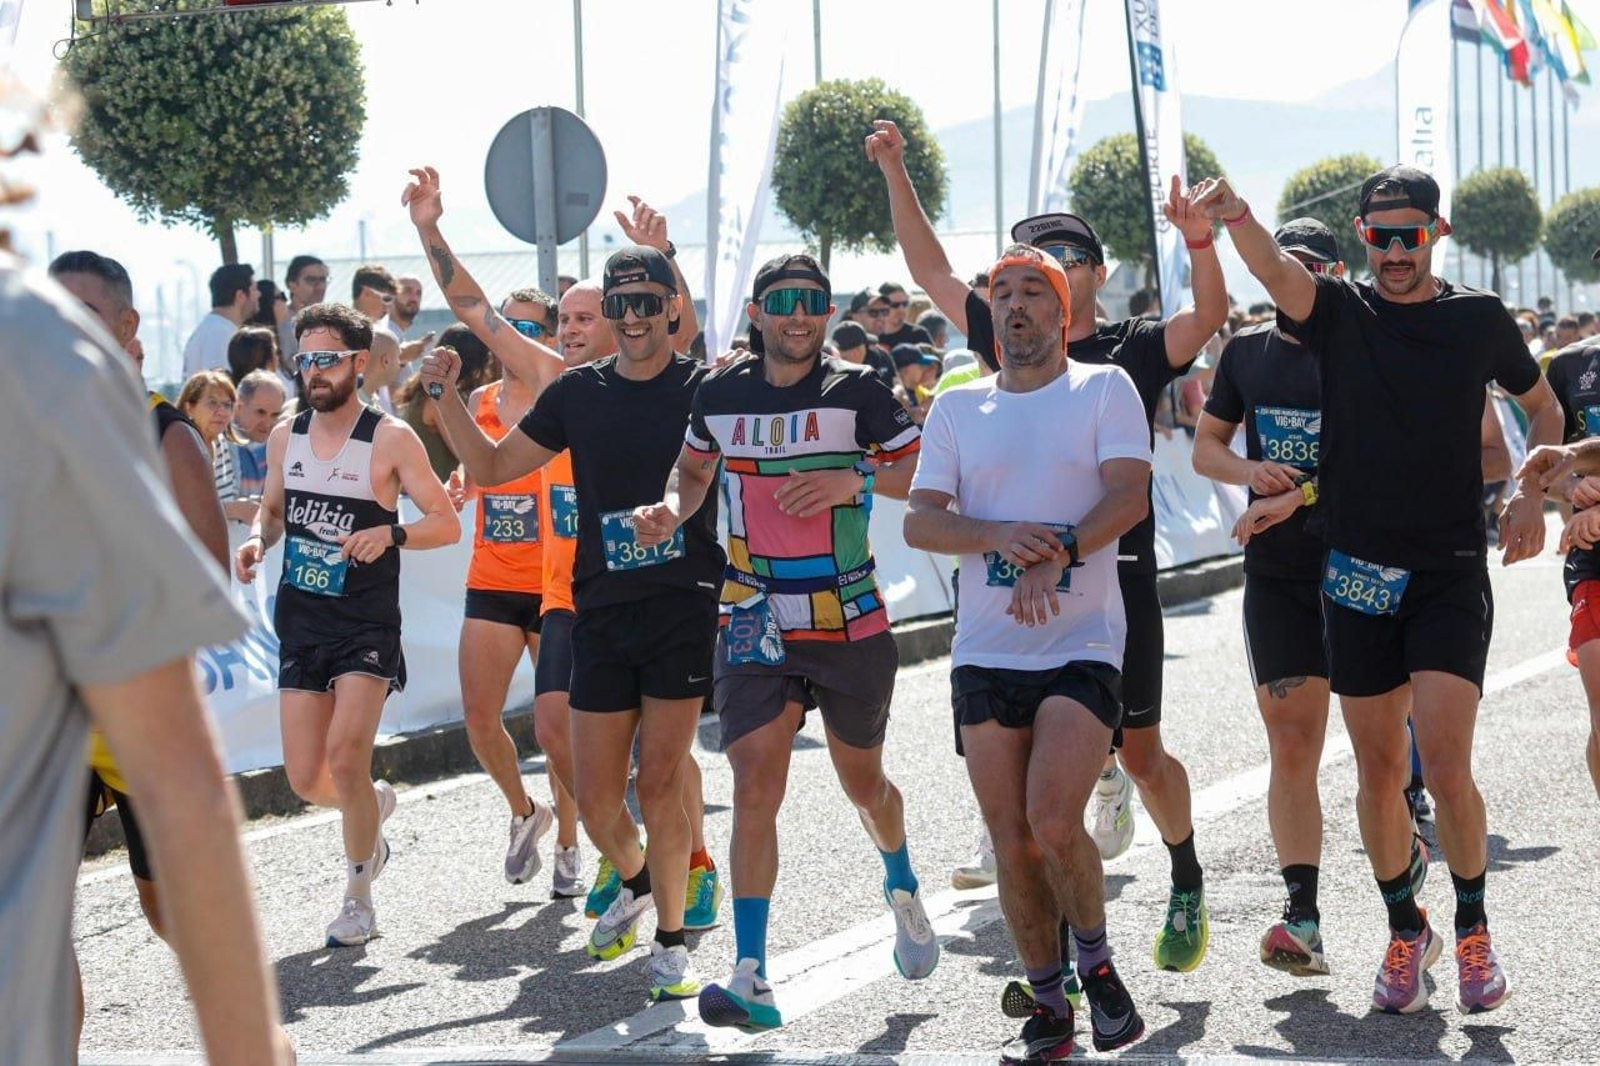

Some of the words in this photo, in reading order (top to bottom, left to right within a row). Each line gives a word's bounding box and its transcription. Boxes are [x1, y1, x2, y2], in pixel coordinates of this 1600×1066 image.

[1410, 107, 1433, 168] alia
[731, 412, 820, 446] ALOIA
[765, 446, 786, 455] TRAIL
[1268, 439, 1320, 461] 3838
[319, 525, 340, 538] fresh
[492, 519, 525, 537] 233
[295, 565, 330, 588] 166
[1335, 575, 1391, 610] 3843
